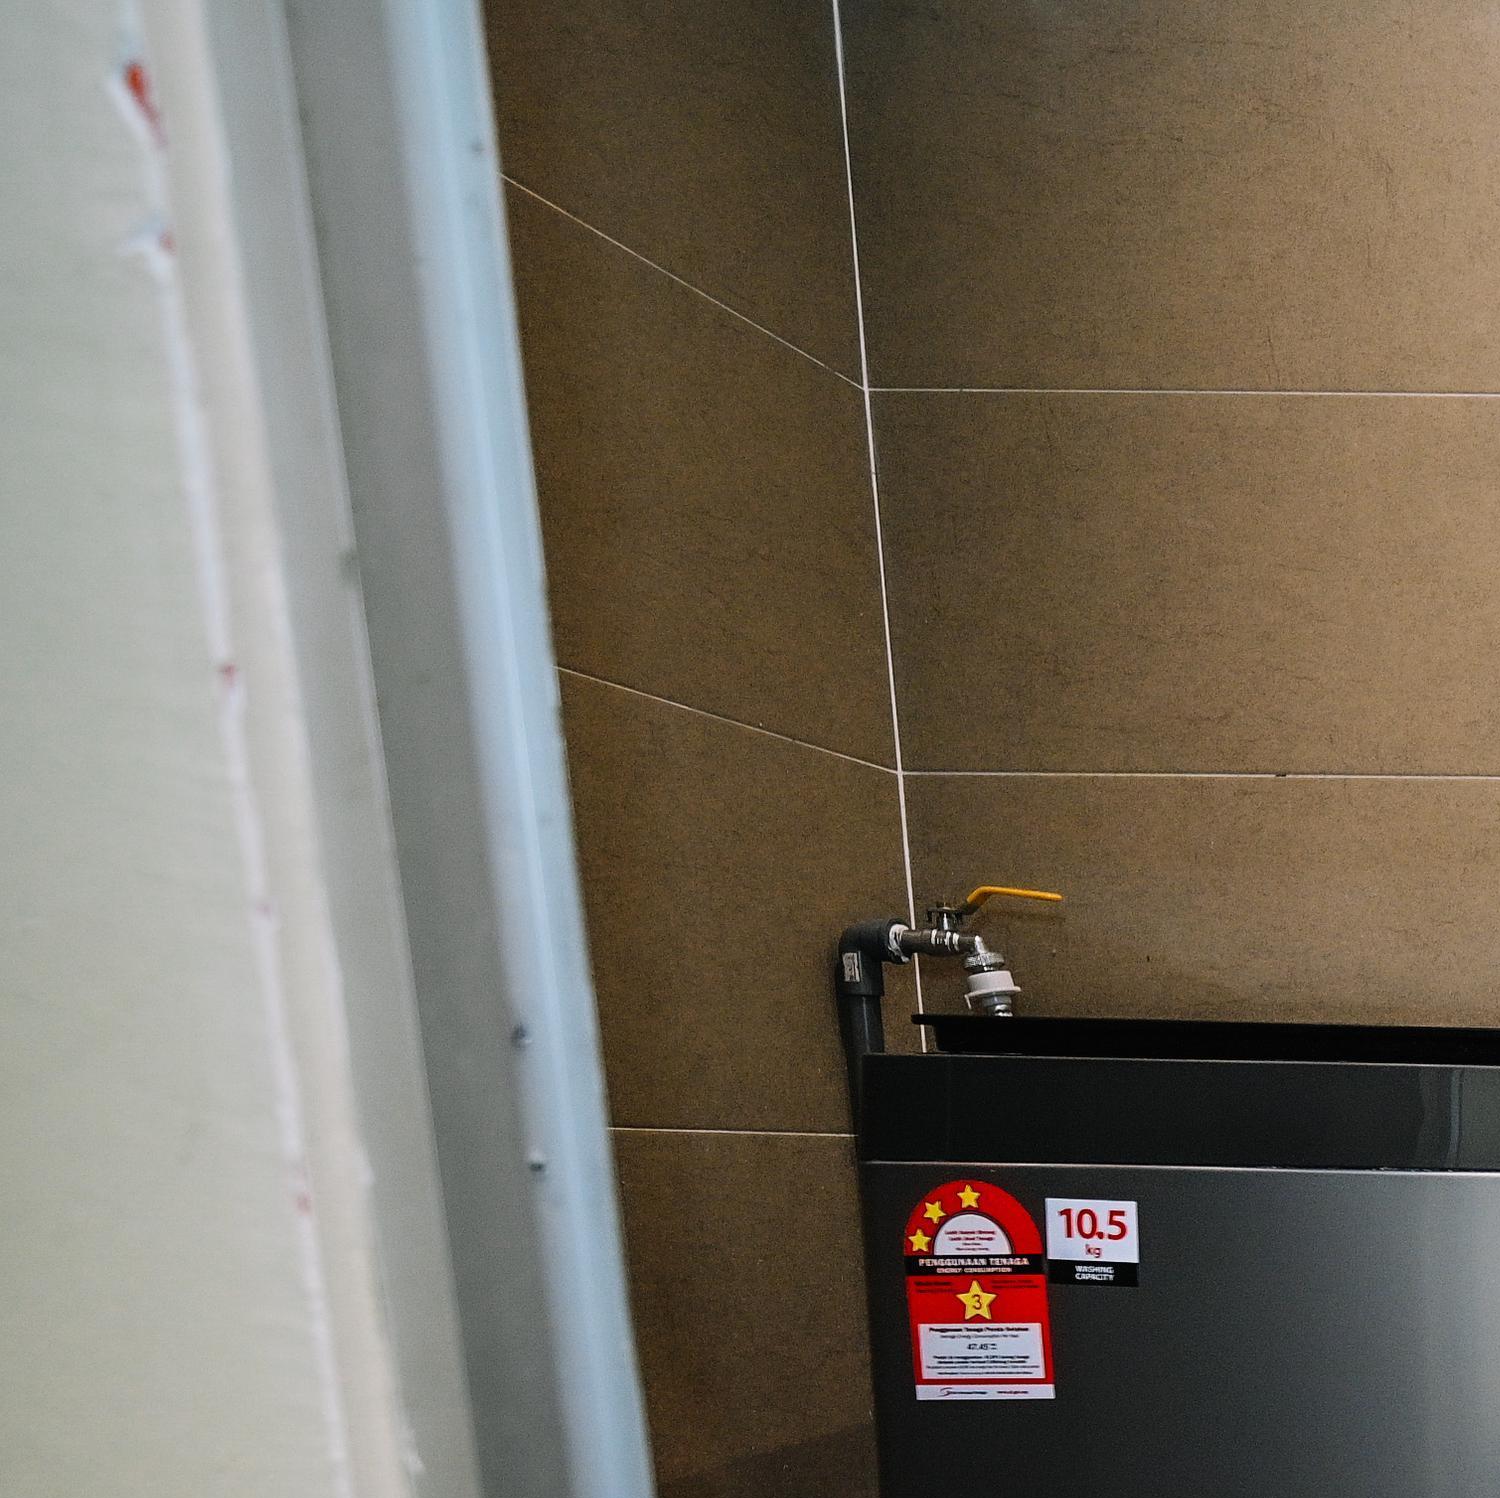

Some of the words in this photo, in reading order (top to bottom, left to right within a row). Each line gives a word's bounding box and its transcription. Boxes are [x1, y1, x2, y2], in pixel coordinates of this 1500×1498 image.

[1058, 1208, 1127, 1240] 10.5
[1085, 1244, 1101, 1258] kg
[972, 1294, 982, 1310] 3
